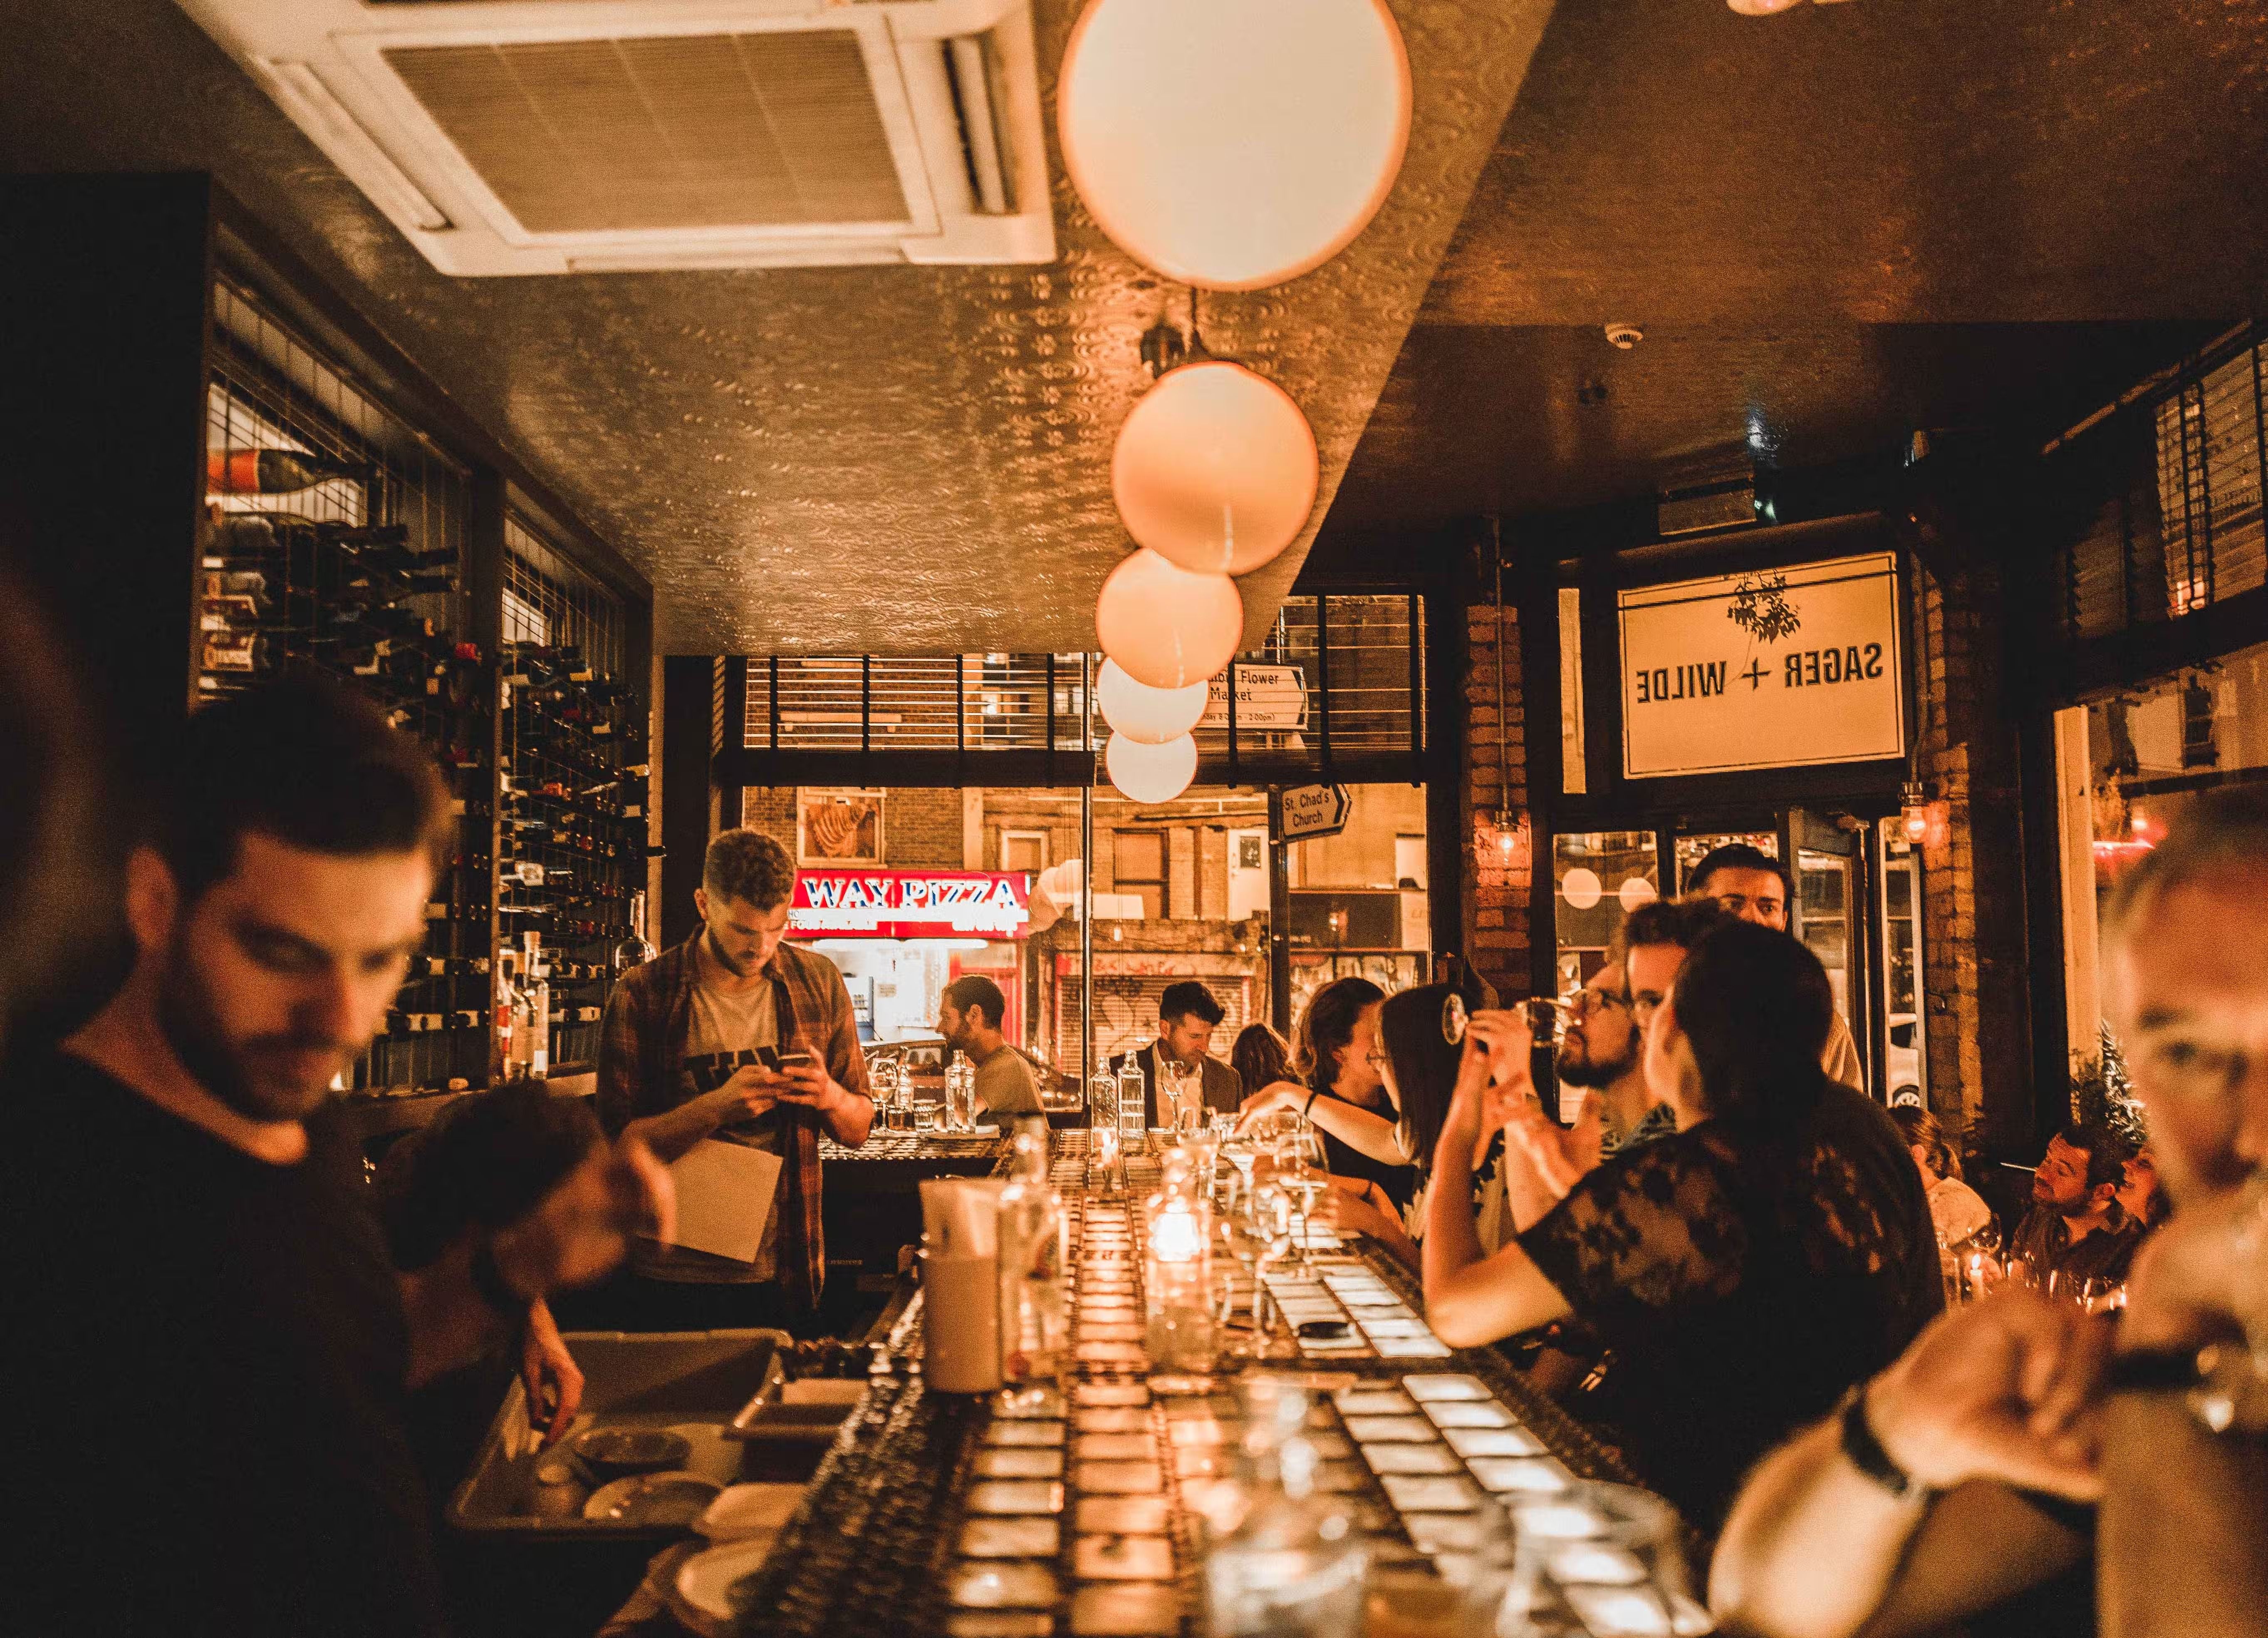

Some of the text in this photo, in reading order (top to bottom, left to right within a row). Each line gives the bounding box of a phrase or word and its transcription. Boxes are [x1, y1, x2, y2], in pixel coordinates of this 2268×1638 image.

[1241, 670, 1279, 684] Flower
[1300, 790, 1330, 808] Chad's
[1293, 810, 1323, 827] Church
[802, 877, 1017, 909] WAY PIZZA
